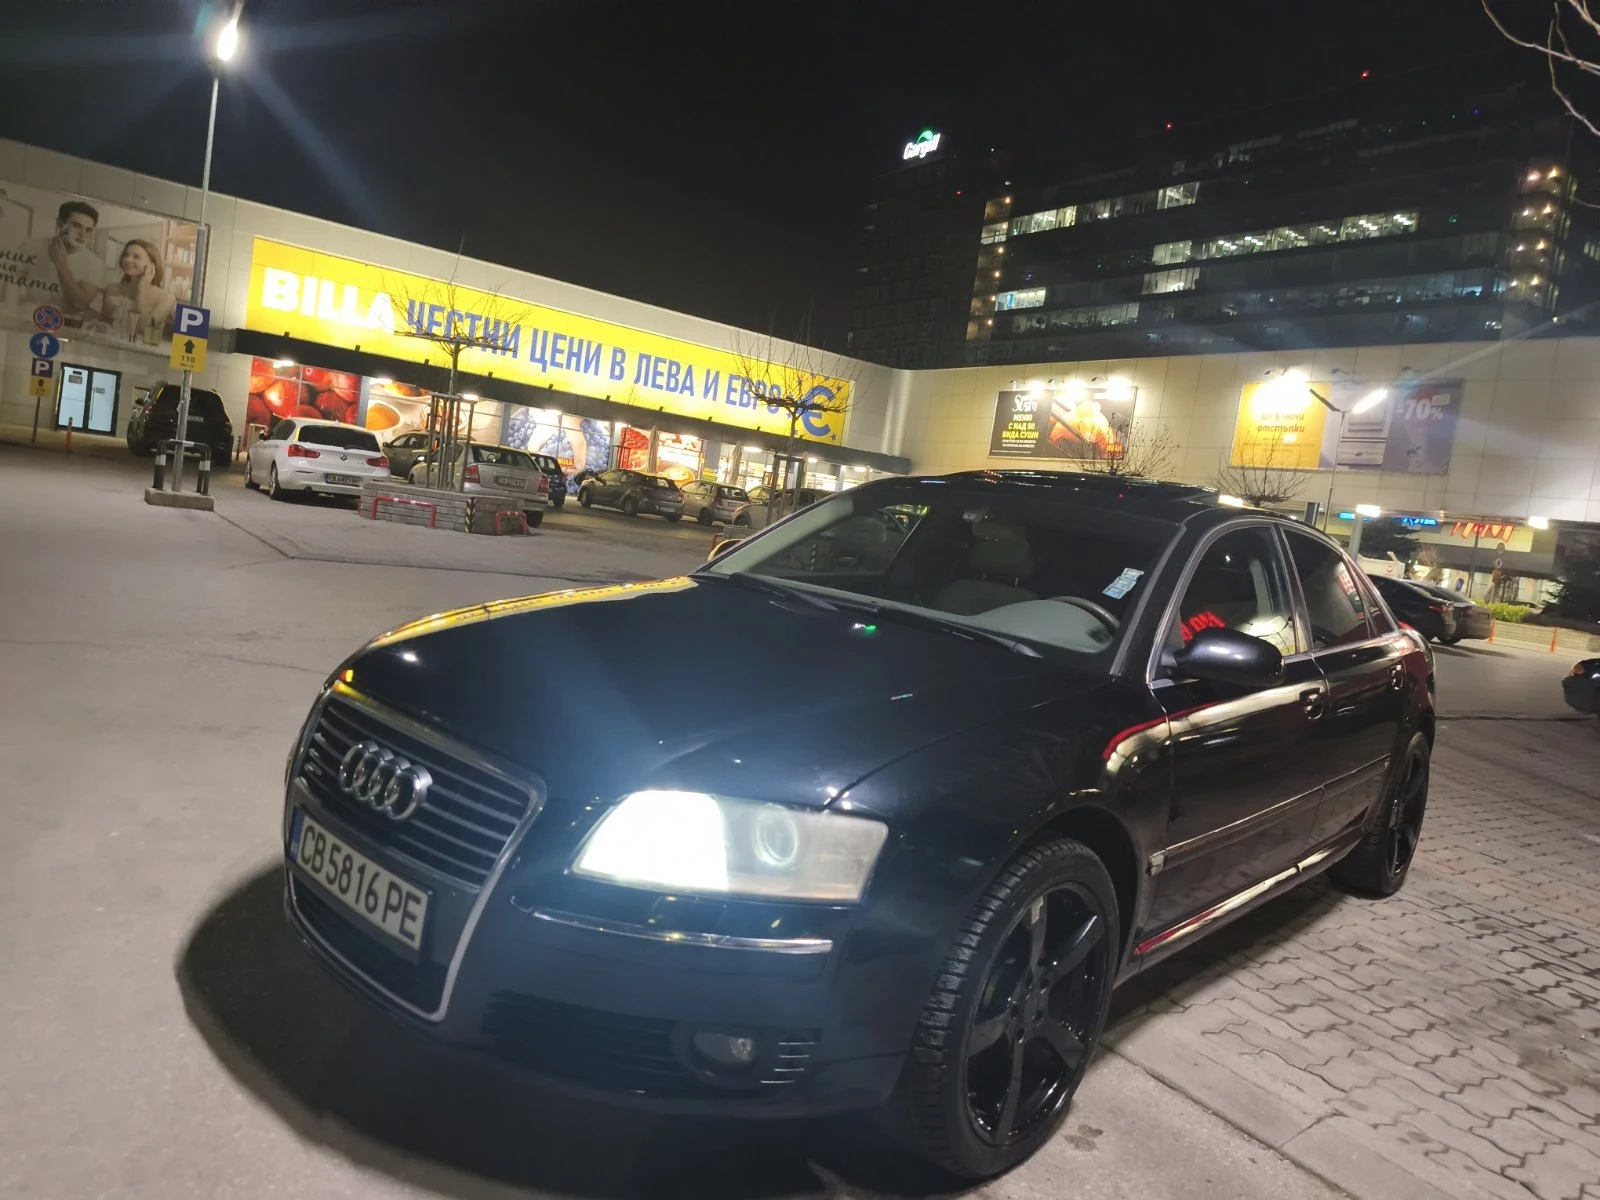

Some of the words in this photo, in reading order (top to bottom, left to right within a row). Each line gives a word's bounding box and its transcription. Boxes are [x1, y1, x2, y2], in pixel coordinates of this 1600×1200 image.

[180, 307, 204, 333] P
[262, 267, 395, 333] BILLA
[35, 361, 50, 375] P
[407, 299, 521, 359] ЧЕСТНИ
[529, 328, 602, 376] ЦЕНИ
[609, 346, 626, 381] В
[634, 352, 695, 396] ЛЕВА
[703, 368, 720, 402] И
[725, 373, 781, 414] ЕВРО
